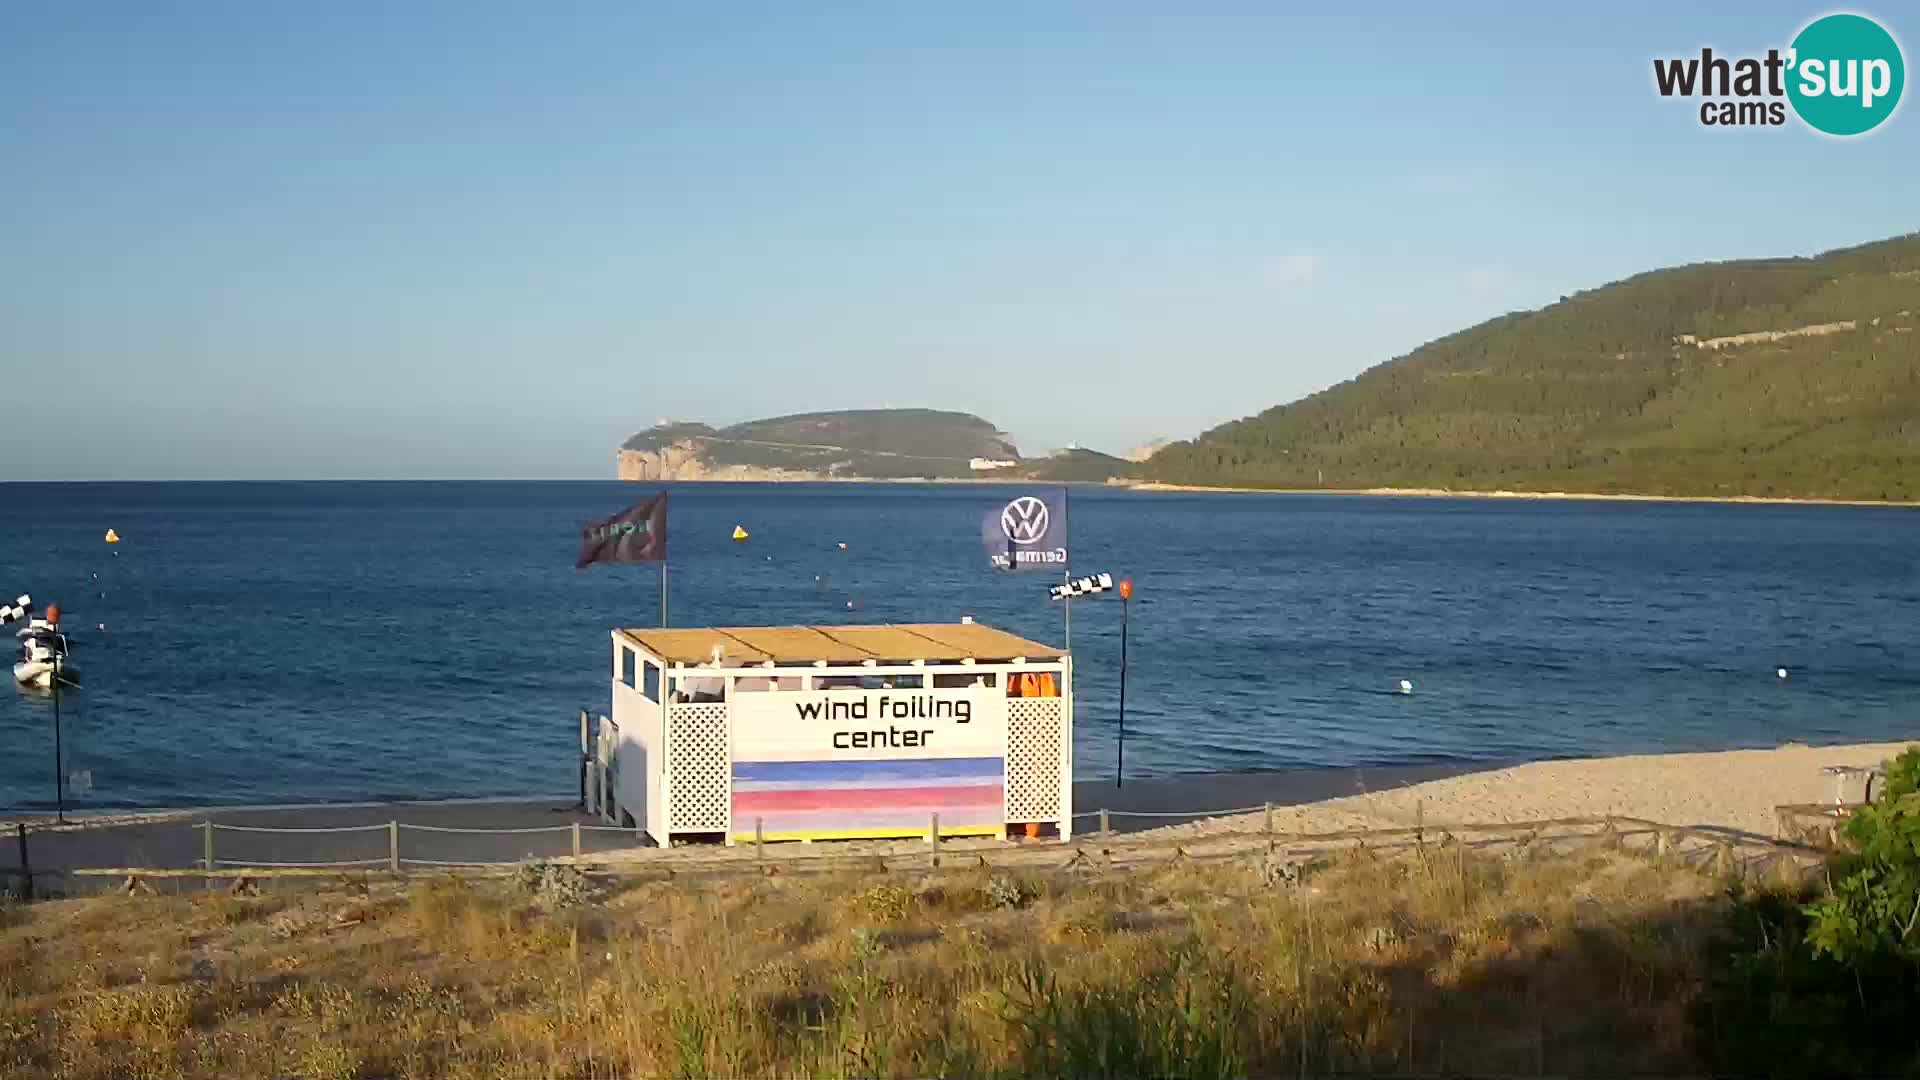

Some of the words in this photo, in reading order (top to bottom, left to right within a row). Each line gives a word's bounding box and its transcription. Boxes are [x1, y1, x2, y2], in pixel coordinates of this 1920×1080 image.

[795, 695, 868, 720] wind
[879, 695, 971, 724] foiling
[833, 725, 934, 749] center
